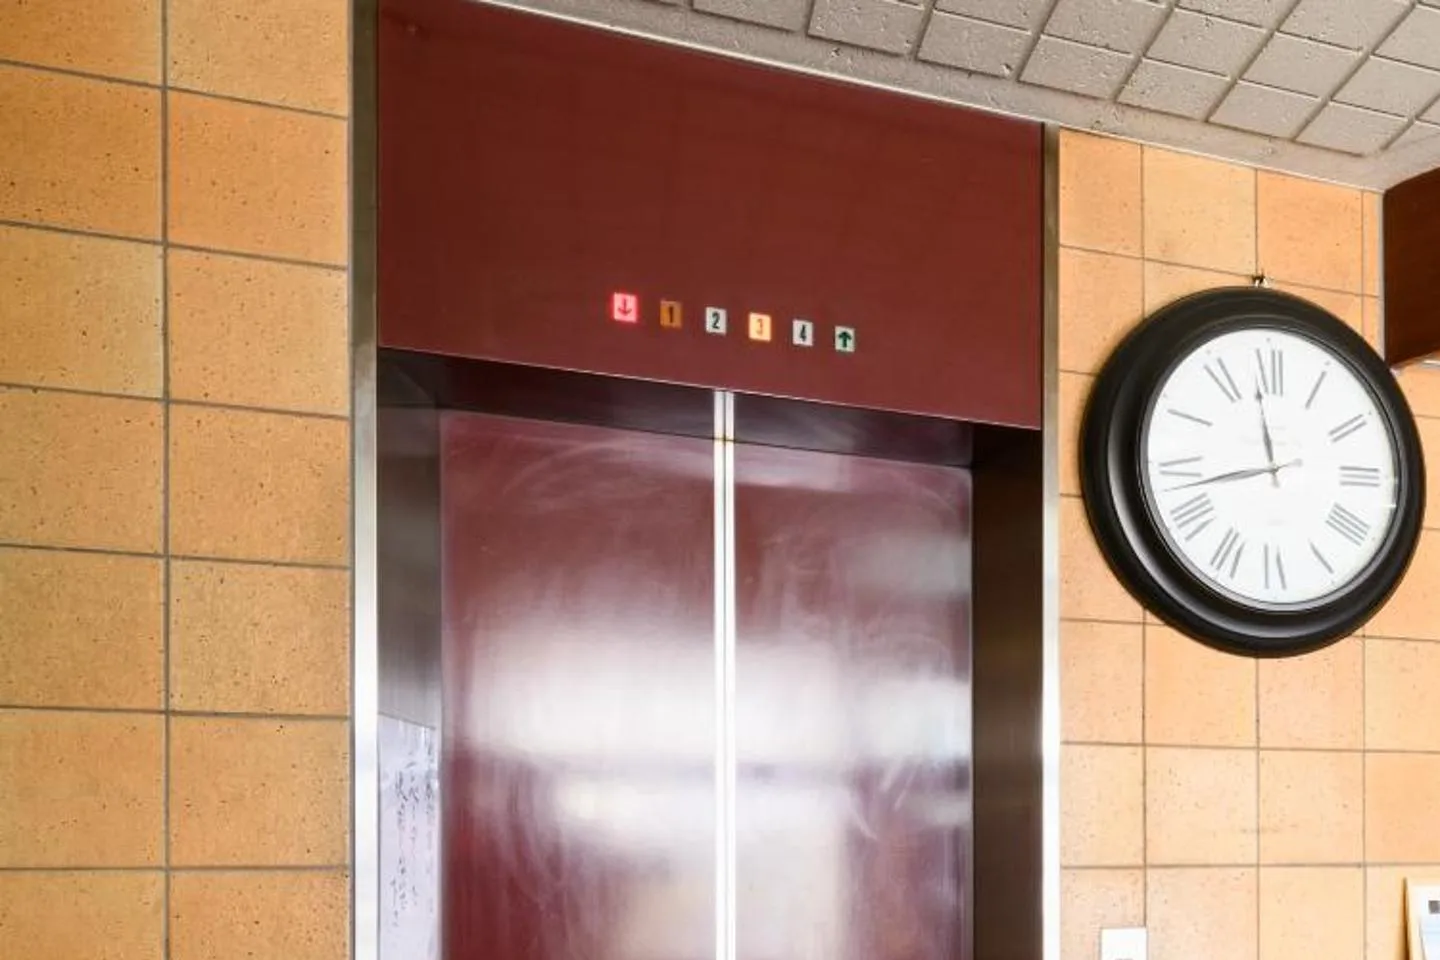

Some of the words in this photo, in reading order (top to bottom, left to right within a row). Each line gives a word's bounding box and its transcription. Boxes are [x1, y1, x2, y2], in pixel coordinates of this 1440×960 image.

[711, 311, 721, 330] 2
[754, 317, 765, 336] 3
[798, 323, 808, 343] 4
